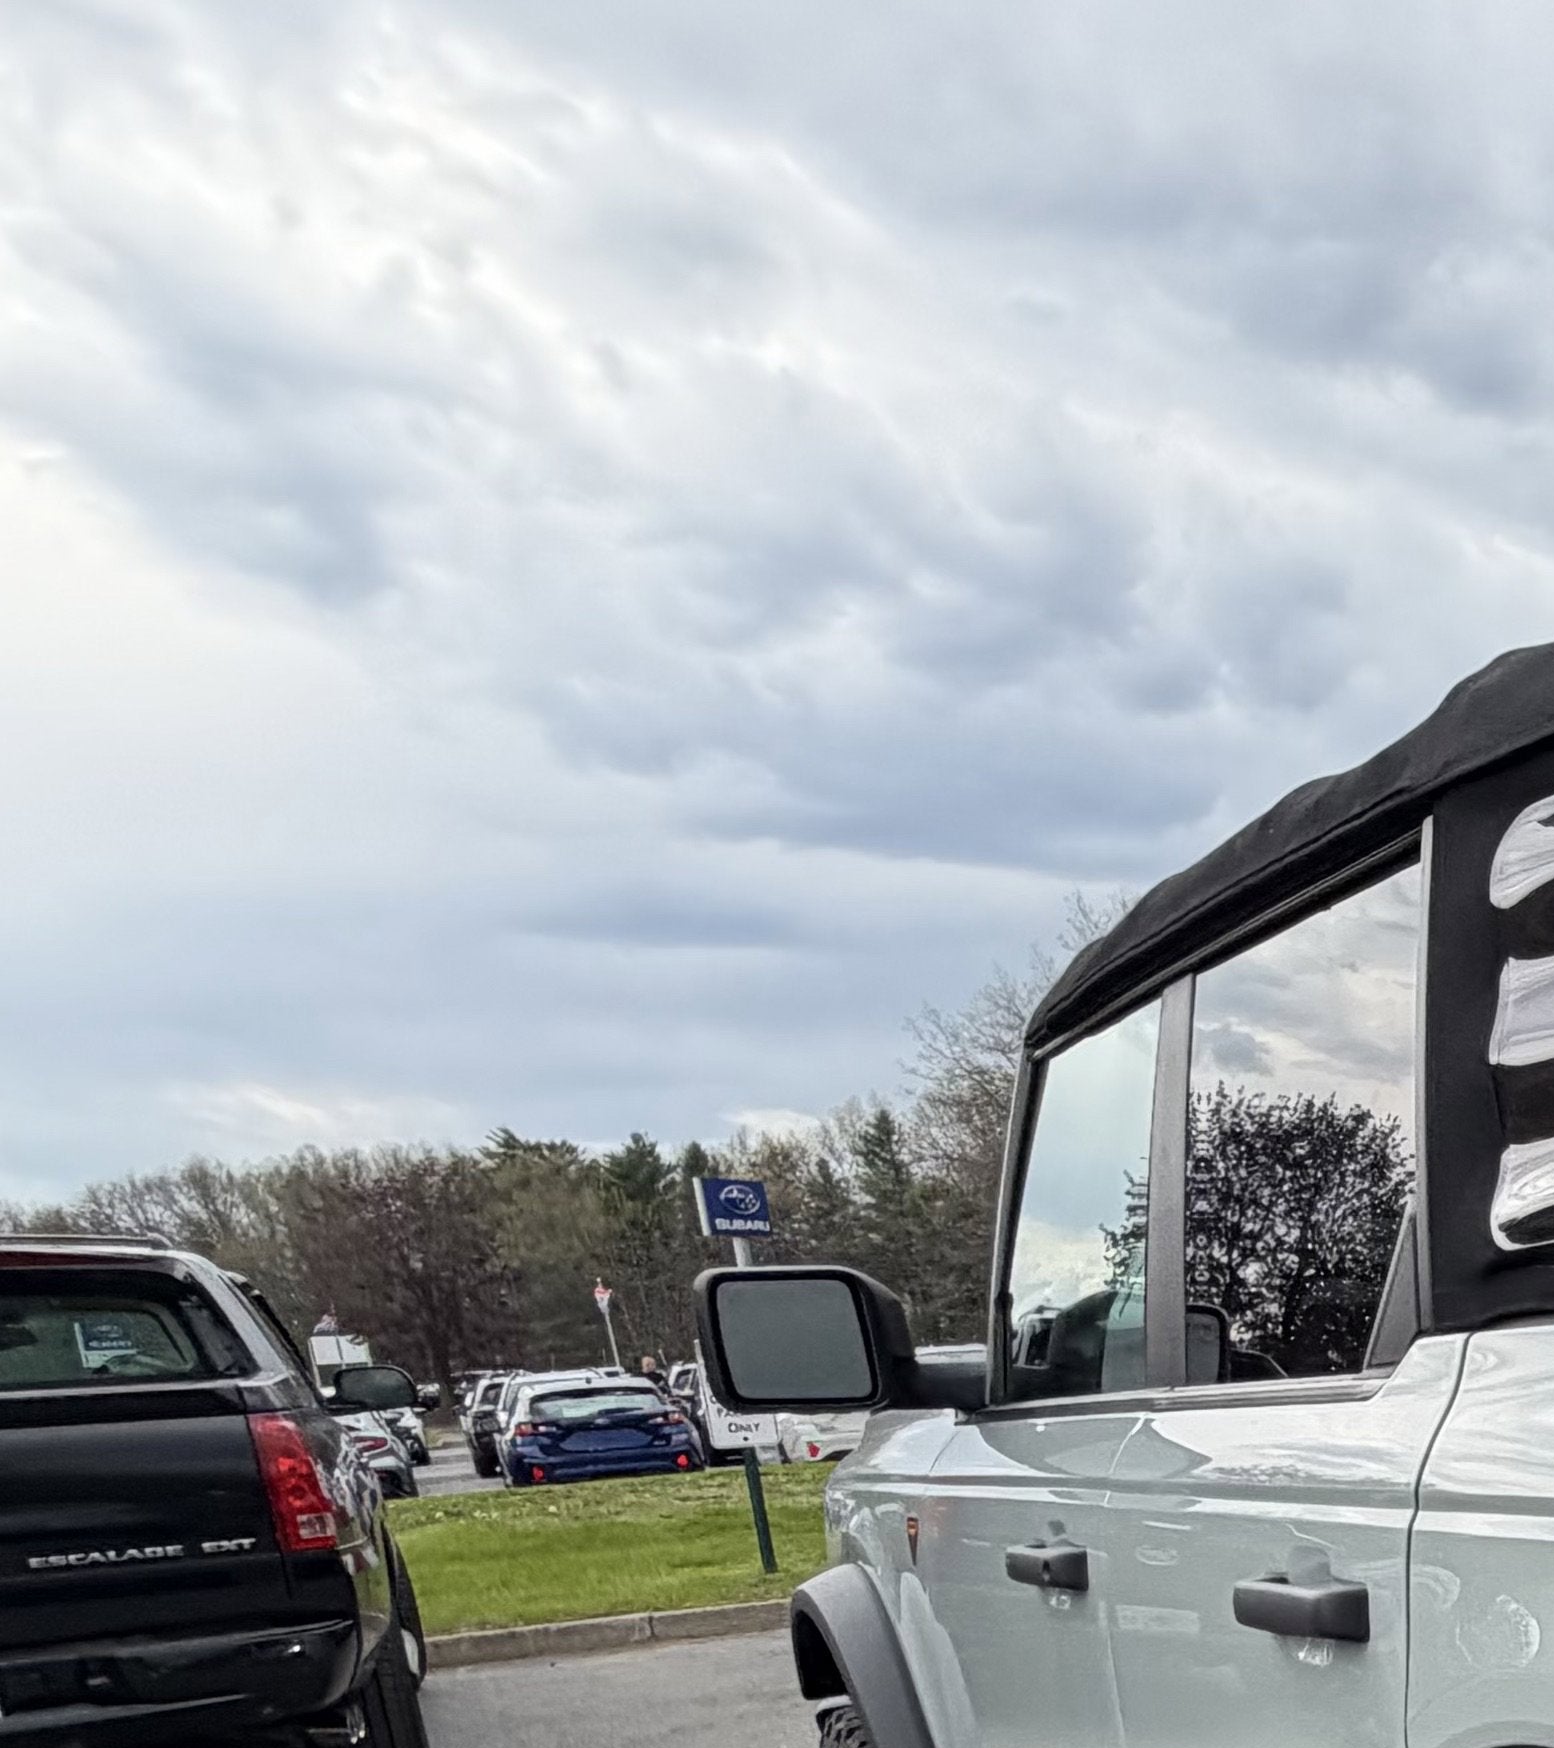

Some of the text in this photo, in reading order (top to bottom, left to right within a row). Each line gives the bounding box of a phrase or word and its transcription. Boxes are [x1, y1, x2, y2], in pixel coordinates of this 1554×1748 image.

[715, 1217, 770, 1231] SUBARU
[28, 1537, 256, 1568] ESCALADE EXT
